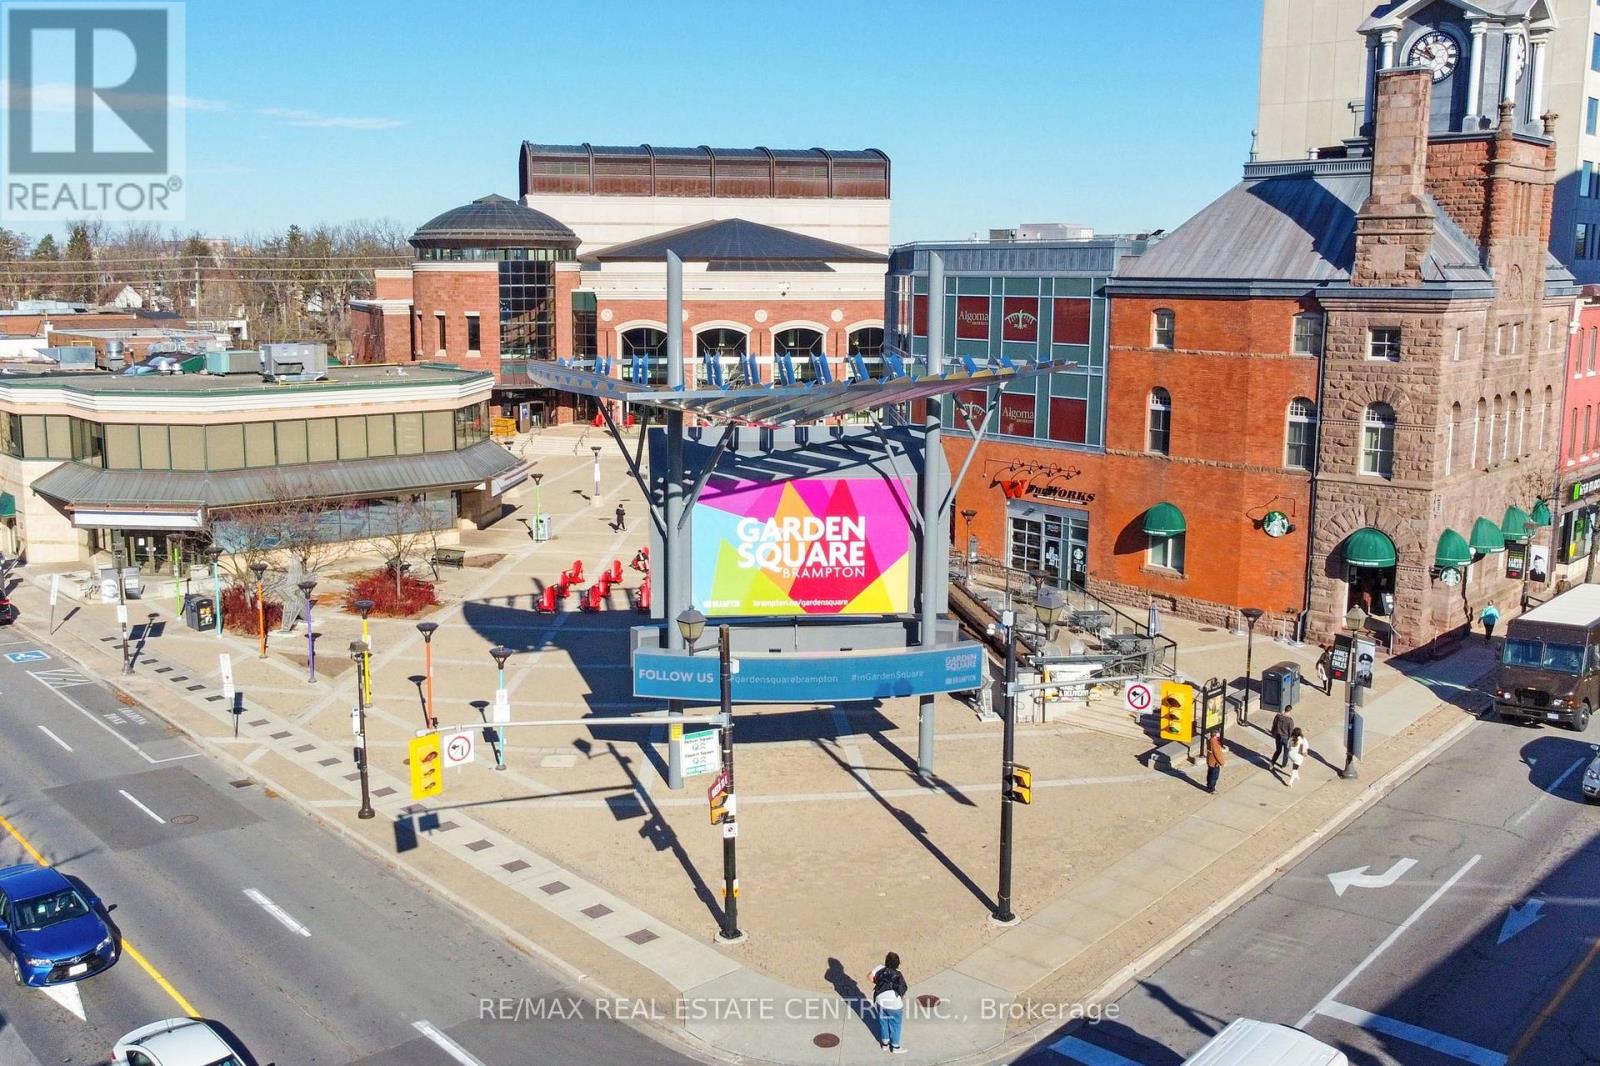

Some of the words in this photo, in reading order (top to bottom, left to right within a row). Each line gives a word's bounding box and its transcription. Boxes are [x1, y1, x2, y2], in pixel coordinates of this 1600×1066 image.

[958, 311, 988, 321] Algoma
[1002, 407, 1034, 419] Algoma
[736, 517, 866, 542] GARDEN
[736, 542, 866, 572] SQUARE
[782, 567, 866, 578] BRAMPTON
[639, 669, 693, 682] FOLLOW
[697, 672, 714, 683] US
